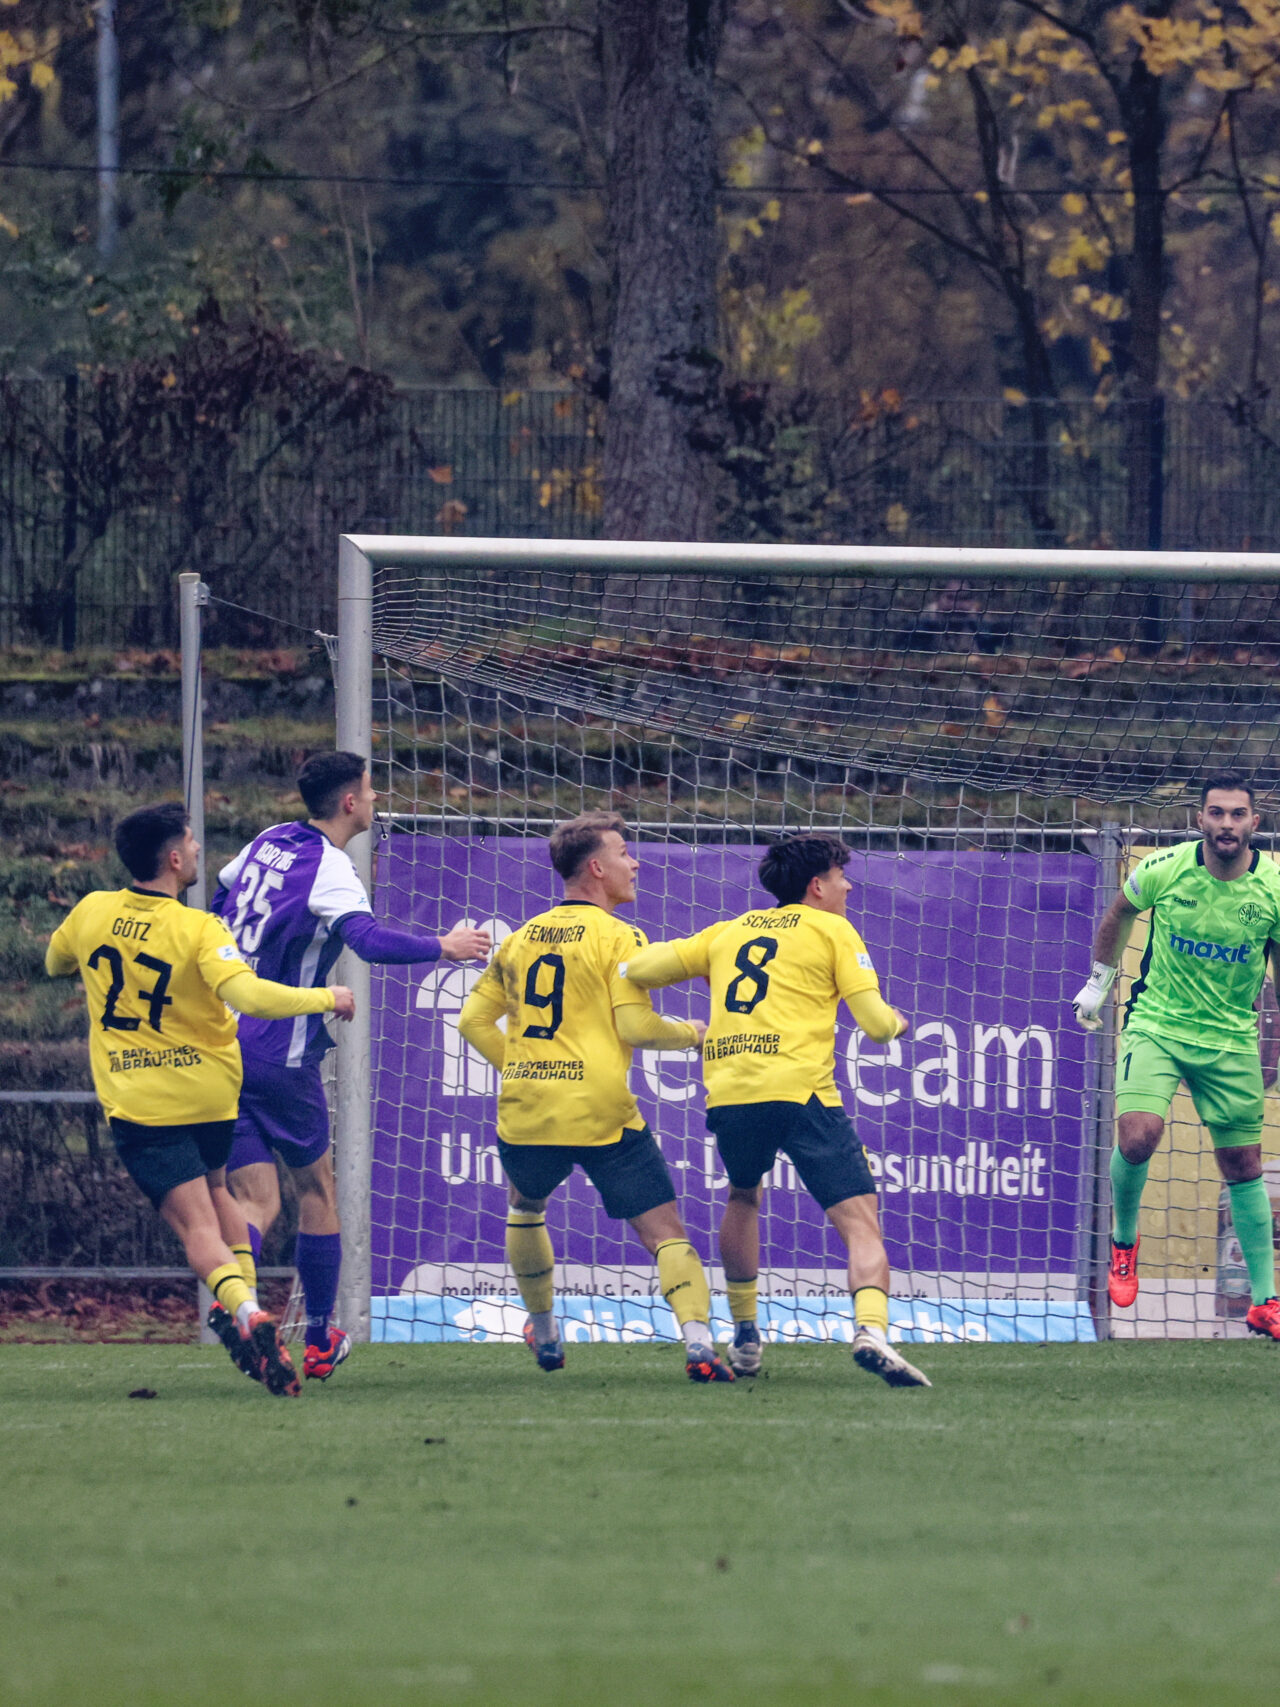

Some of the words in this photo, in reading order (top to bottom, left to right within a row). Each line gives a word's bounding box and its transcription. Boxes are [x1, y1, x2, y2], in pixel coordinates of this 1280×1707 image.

[232, 861, 285, 954] 35
[112, 917, 152, 942] GÖTZ
[524, 923, 586, 944] FENNINGER
[1170, 934, 1251, 964] maxit
[725, 936, 779, 1015] 8
[87, 944, 173, 1034] 27
[522, 952, 566, 1041] 9
[122, 1044, 198, 1060] BAYRUTHER
[717, 1033, 781, 1048] BAYREUTHER
[717, 1043, 780, 1060] BRAUHAUS
[513, 1070, 585, 1082] BRAUHAUS
[517, 1060, 585, 1071] BAYREUTHER
[1122, 1051, 1133, 1082] 1
[866, 1141, 1045, 1197] esundheit
[441, 1281, 519, 1296] meditea
